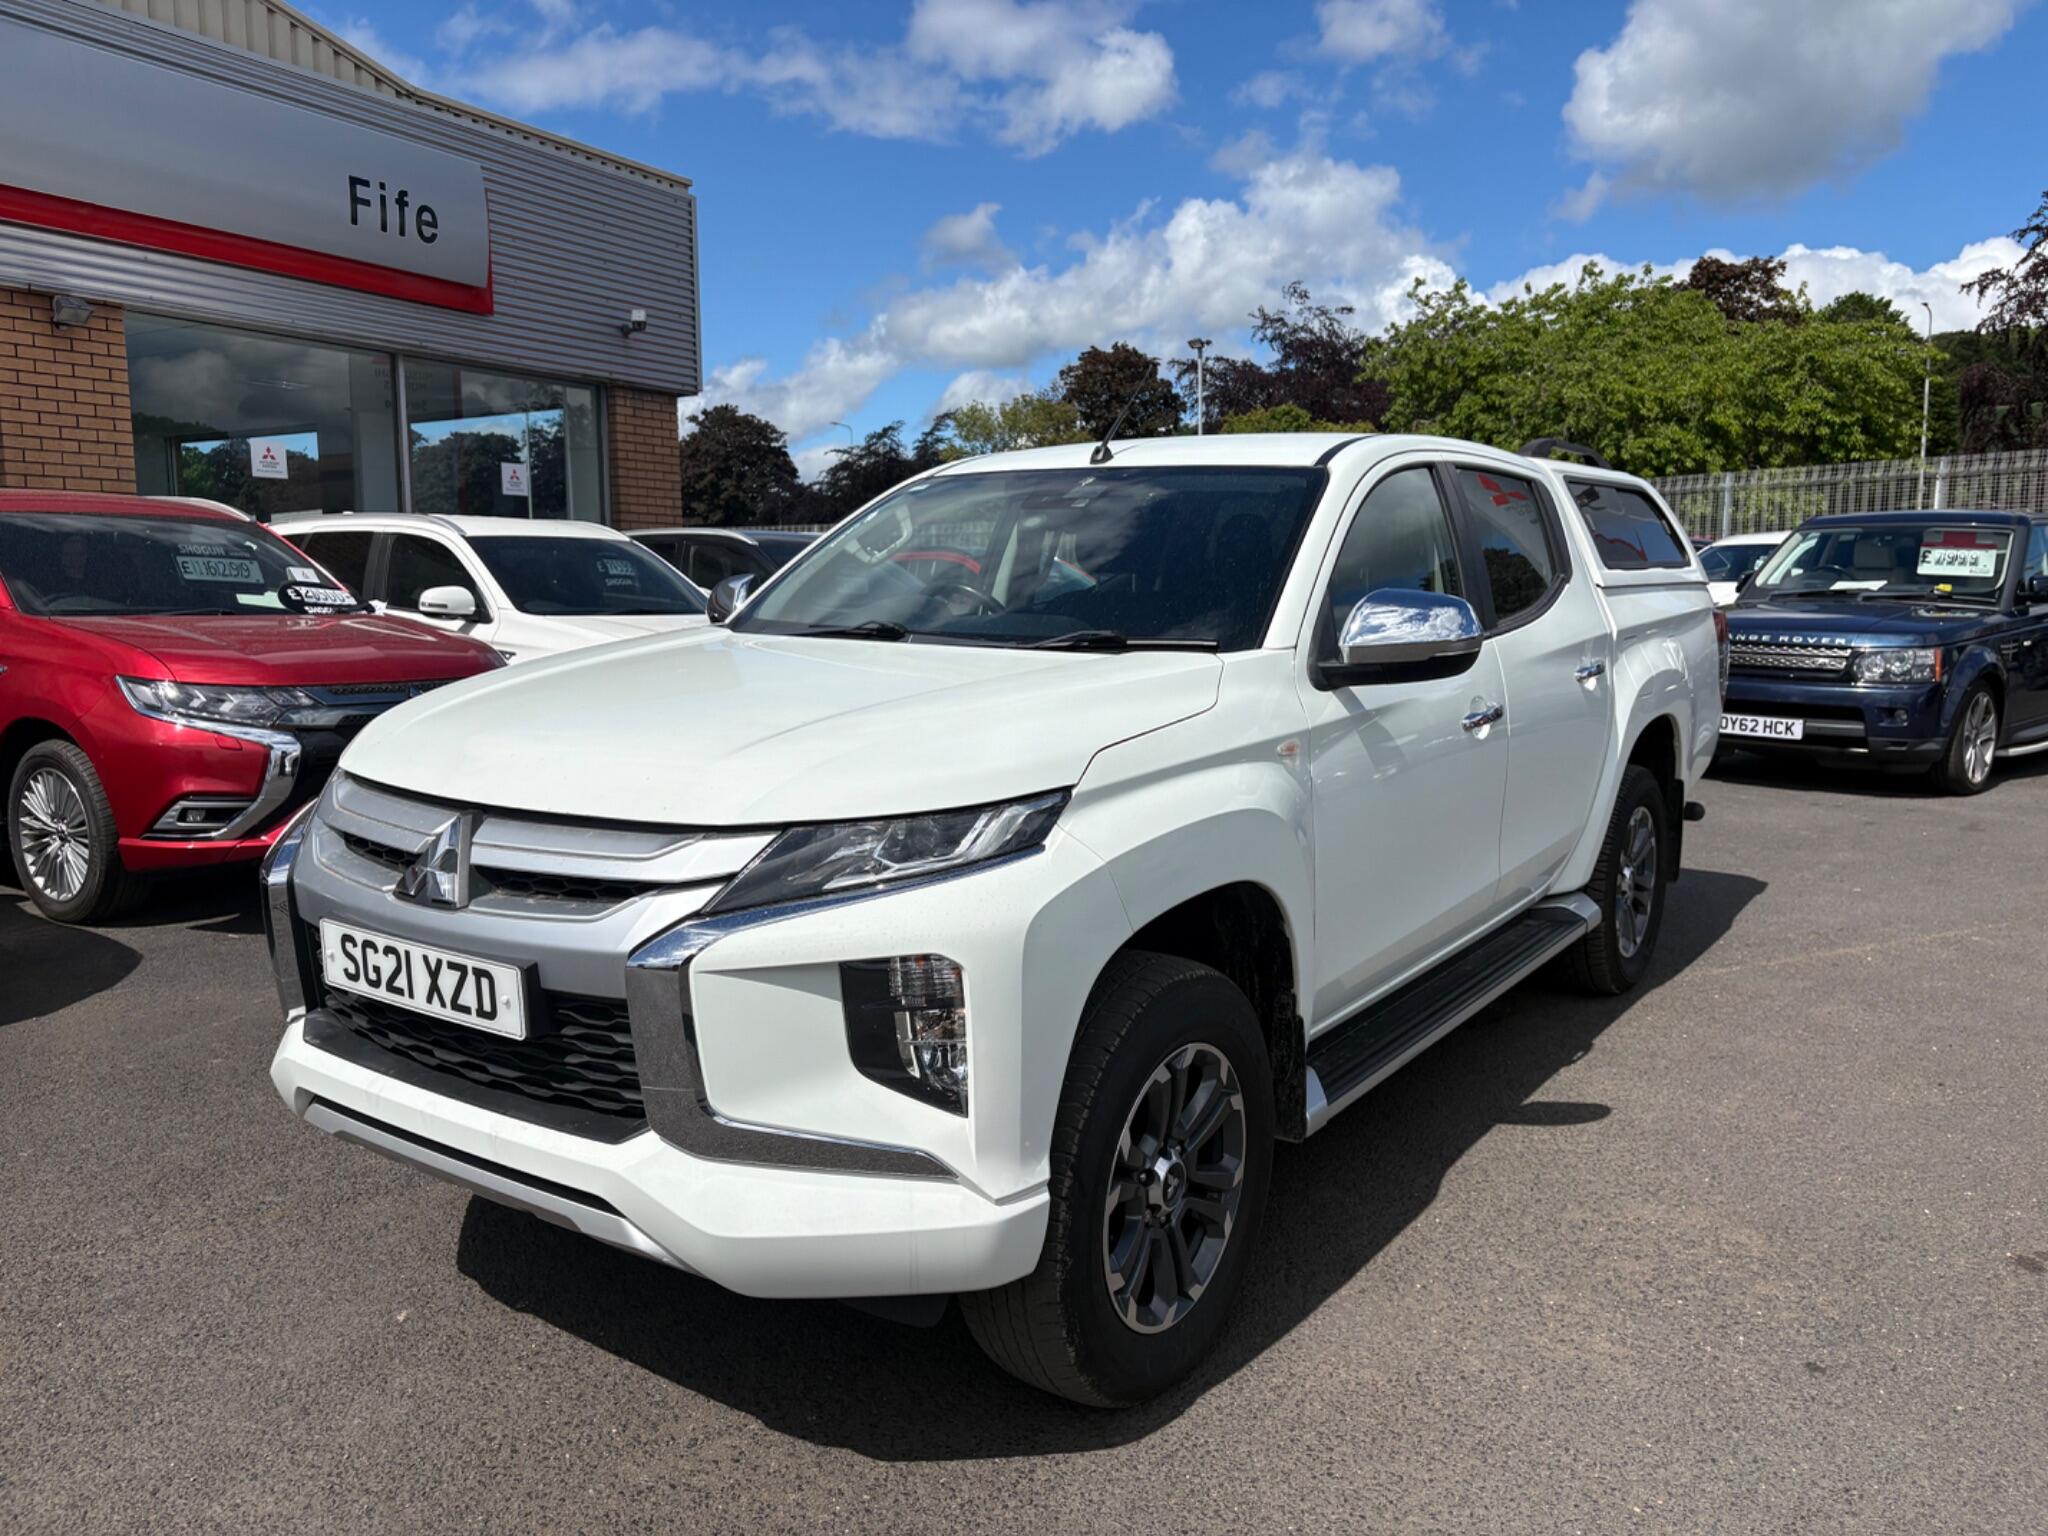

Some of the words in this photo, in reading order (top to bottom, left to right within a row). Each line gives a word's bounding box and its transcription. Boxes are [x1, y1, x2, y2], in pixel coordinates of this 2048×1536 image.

[348, 174, 439, 245] Fife
[178, 544, 226, 556] SHOGUN
[1779, 635, 1846, 645] ROVER
[1762, 720, 1796, 736] HCK
[341, 934, 414, 999] SG21
[422, 954, 498, 1021] XZD
